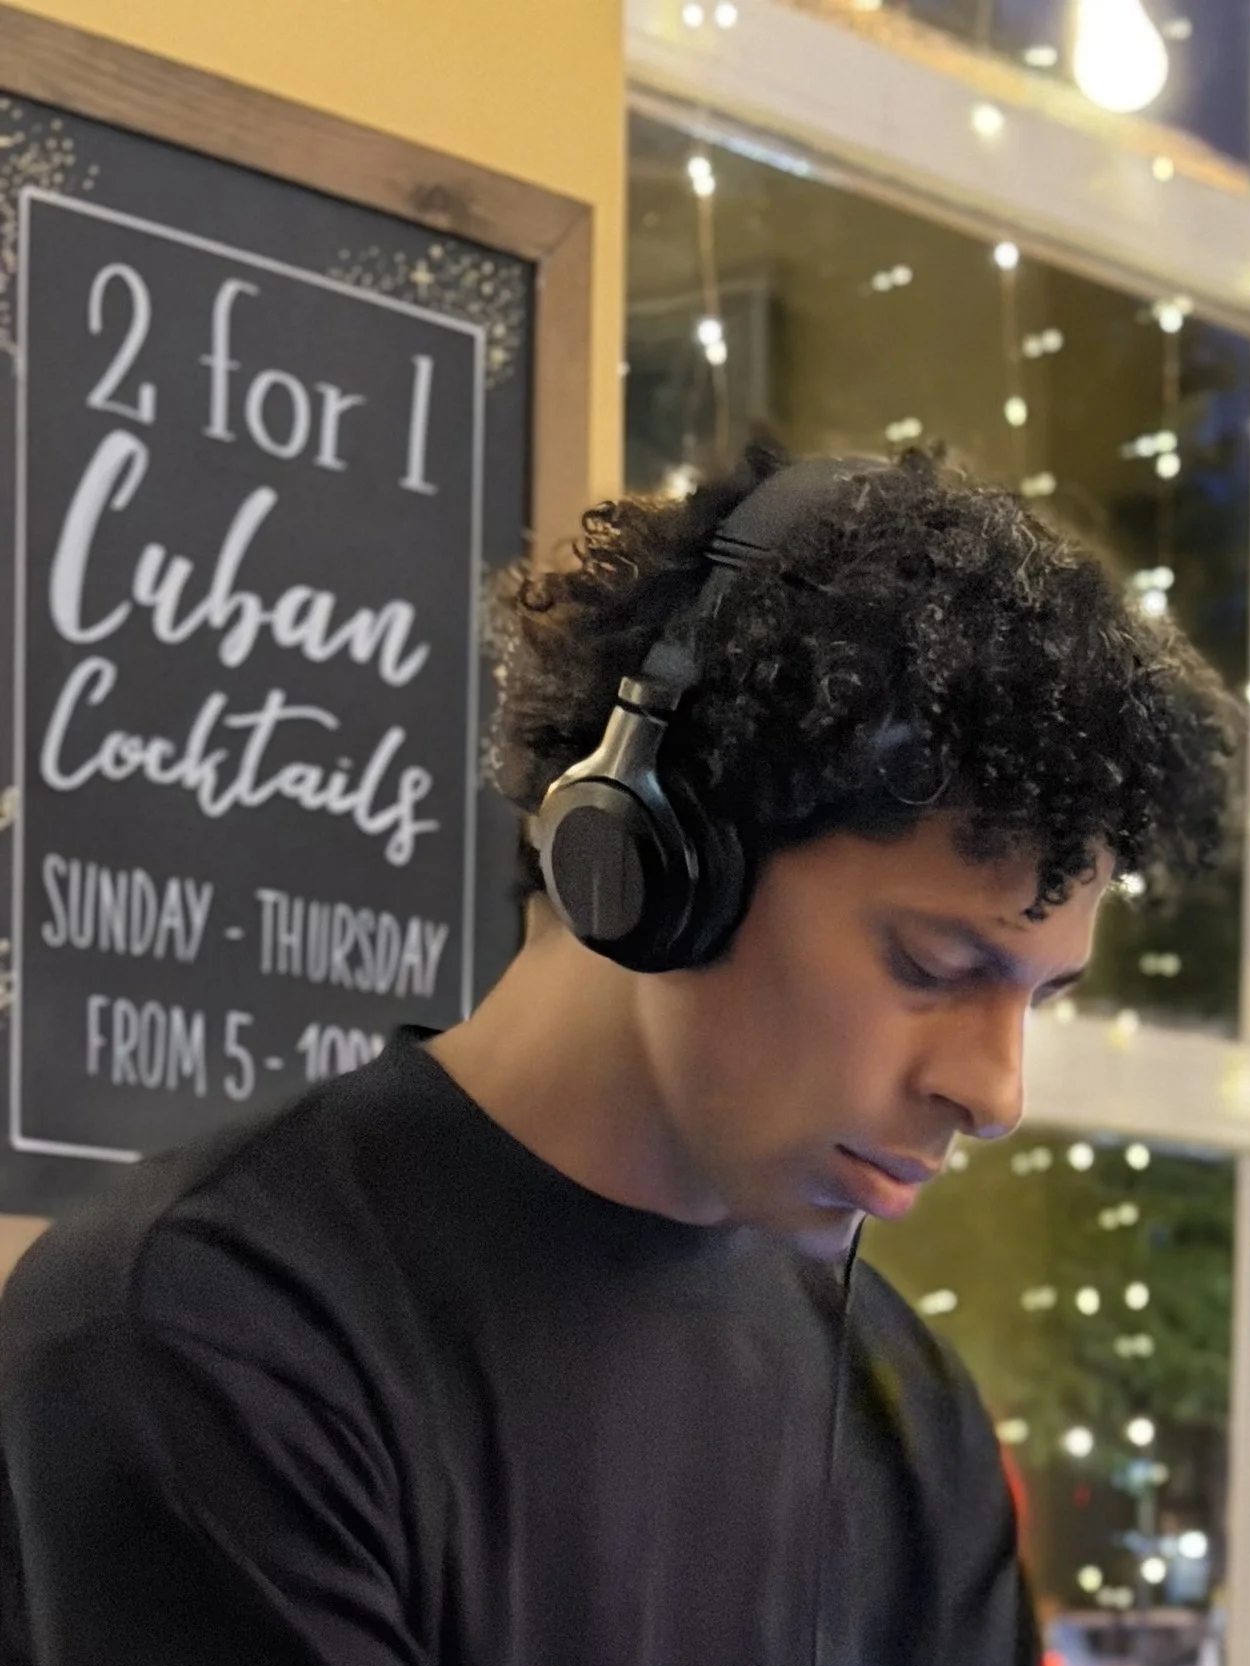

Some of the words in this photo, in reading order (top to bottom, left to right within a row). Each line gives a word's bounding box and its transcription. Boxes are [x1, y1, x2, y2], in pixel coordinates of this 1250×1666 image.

[86, 262, 157, 425] 2
[199, 278, 365, 472] for
[399, 354, 438, 495] 1
[49, 428, 430, 687] Cuban
[40, 656, 440, 867] Cocktails
[41, 853, 213, 962] SUNDAY
[256, 888, 449, 998] THURSDAY
[86, 994, 207, 1098] FROM
[223, 1010, 256, 1101] 5
